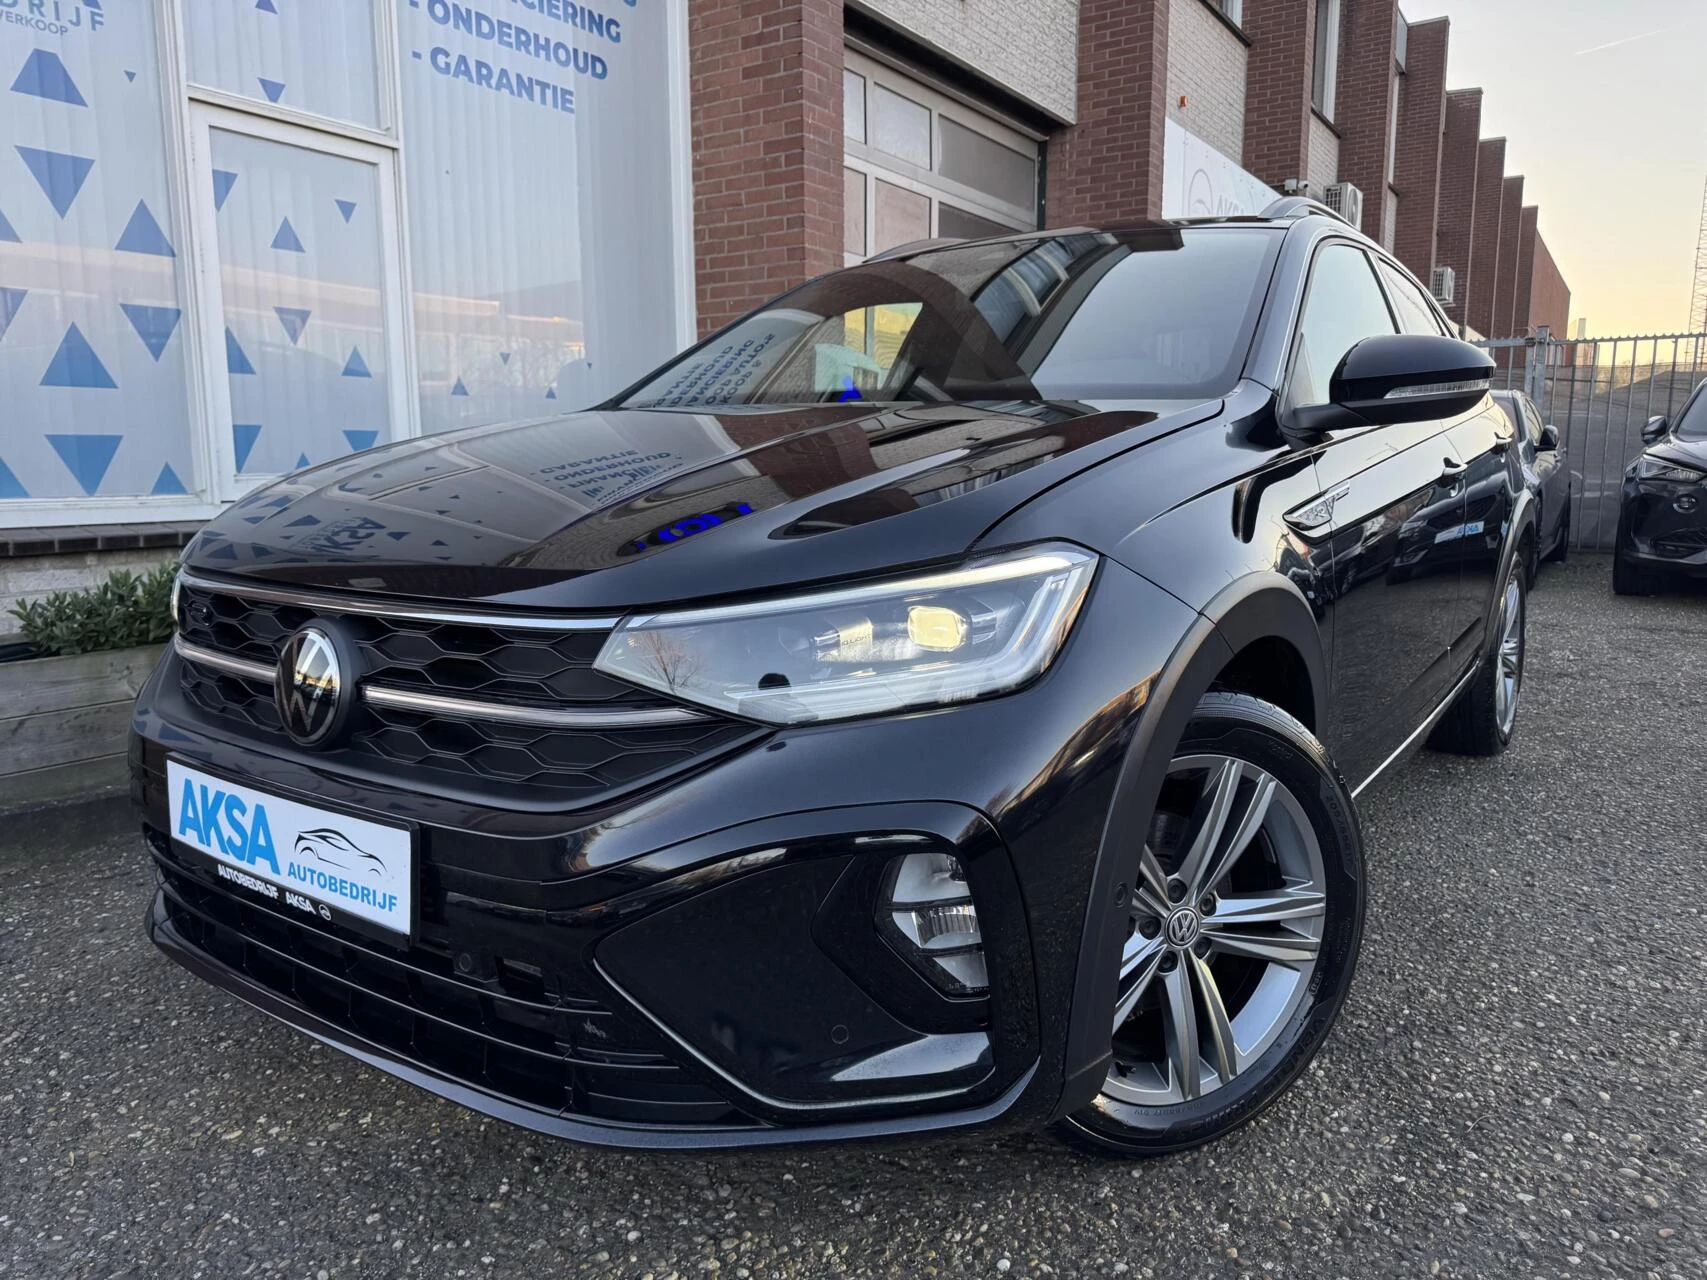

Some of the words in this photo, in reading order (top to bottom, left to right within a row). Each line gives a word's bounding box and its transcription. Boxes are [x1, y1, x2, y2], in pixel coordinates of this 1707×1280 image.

[427, 0, 608, 80] ONDERHOUD
[511, 0, 621, 43] IERING
[430, 46, 576, 114] GARANTIE
[178, 777, 281, 876] AKSA
[217, 863, 279, 900] AUTOBEDRIJF
[285, 890, 317, 916] AKSA
[287, 861, 398, 913] AUTOBEDRIJF
